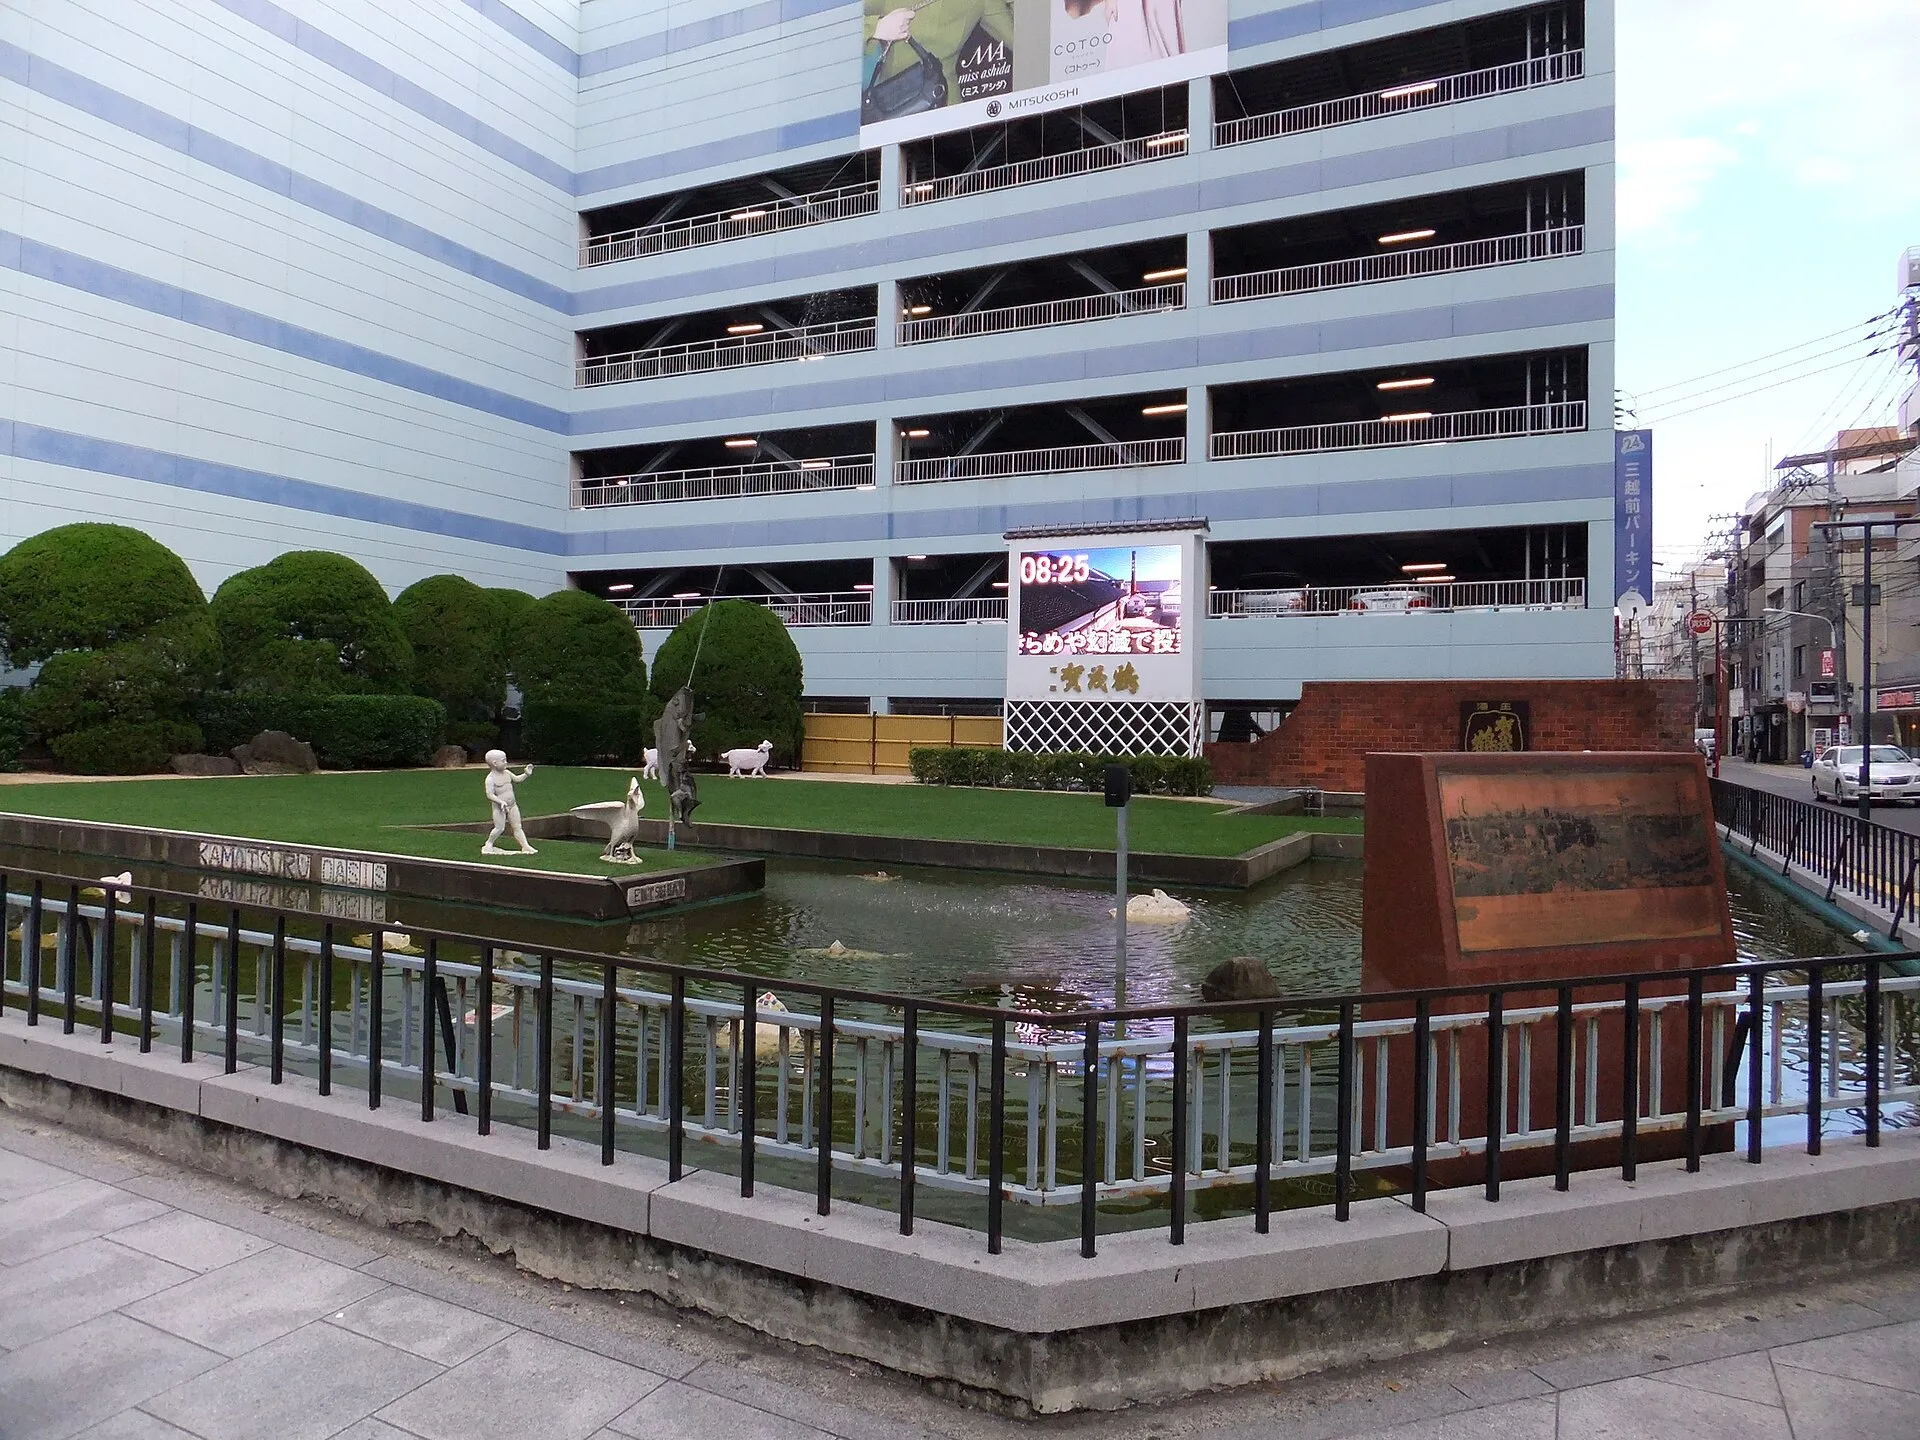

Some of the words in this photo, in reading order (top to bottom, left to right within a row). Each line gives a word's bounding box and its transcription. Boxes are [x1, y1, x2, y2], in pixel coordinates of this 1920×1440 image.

[1053, 33, 1113, 56] COTOO
[957, 69, 980, 84] miss
[980, 61, 1011, 79] ashida
[1008, 87, 1079, 110] MITSUKOSHI
[1020, 554, 1090, 584] 08:25
[321, 857, 387, 890] OASIS
